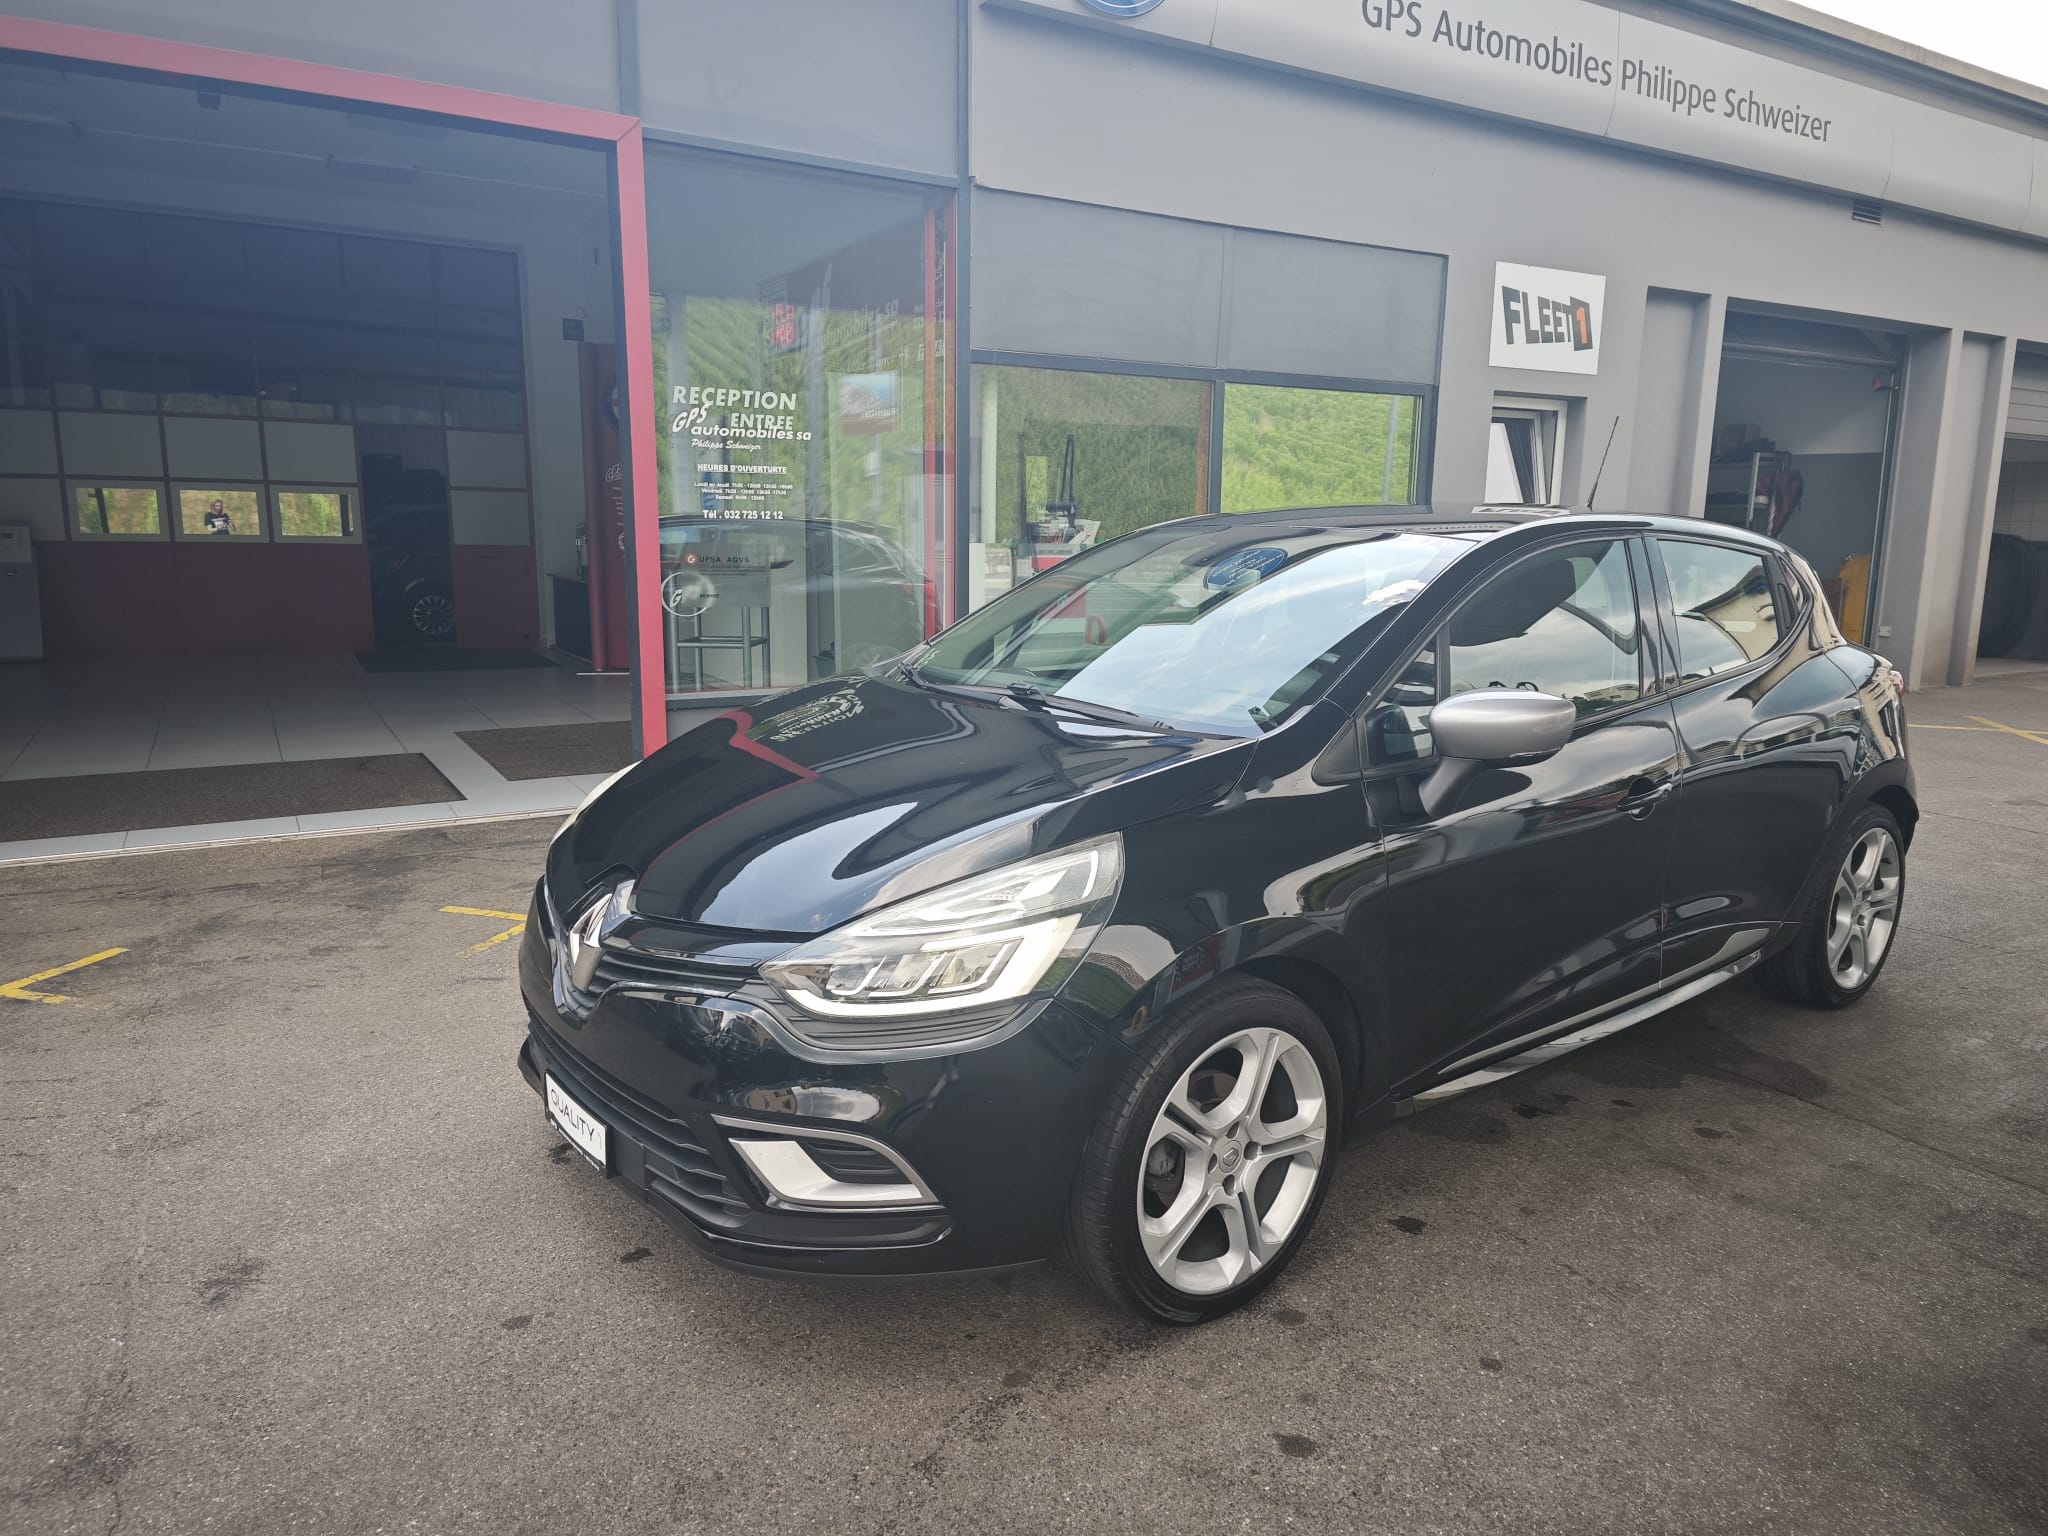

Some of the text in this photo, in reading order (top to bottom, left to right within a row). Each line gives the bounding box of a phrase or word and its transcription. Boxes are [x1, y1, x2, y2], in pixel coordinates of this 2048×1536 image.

[1361, 0, 1832, 142] GPS Automobiles Philippe Schweizer
[672, 385, 797, 411] RECEPTION
[672, 403, 712, 433] GPS
[730, 412, 794, 431] ENTREE
[690, 424, 812, 441] automobiles sa
[690, 438, 762, 453] Philippe Schweizer
[697, 463, 729, 473] HEURES
[724, 510, 741, 520] 032
[741, 510, 758, 520] 725
[760, 510, 771, 520] 12
[773, 511, 784, 520] 12
